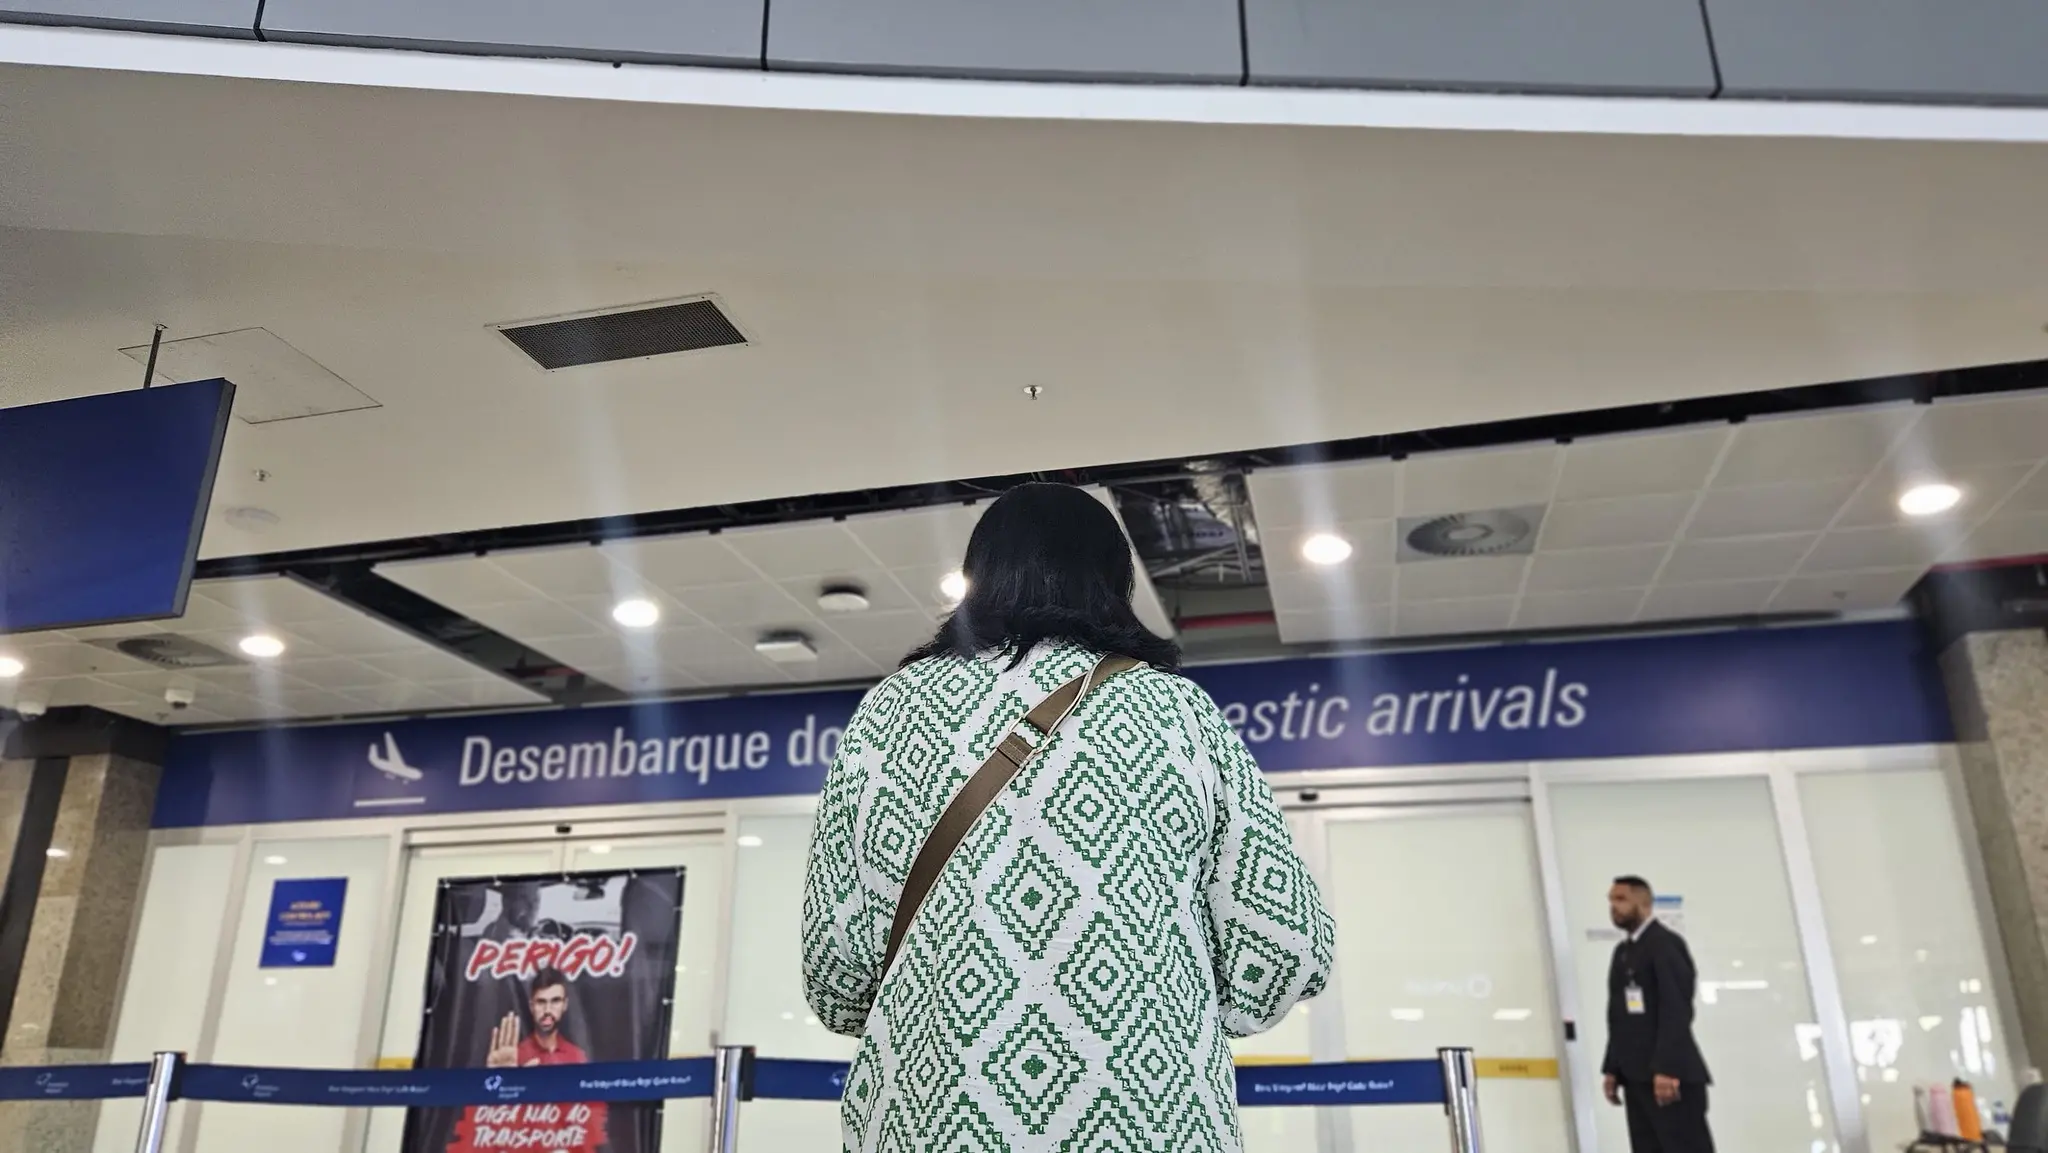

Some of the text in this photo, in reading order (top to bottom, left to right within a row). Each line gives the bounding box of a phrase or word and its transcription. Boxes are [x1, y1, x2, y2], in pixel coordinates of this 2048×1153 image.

[1366, 667, 1589, 737] arrivals
[459, 727, 771, 786] Desembarque
[466, 932, 637, 981] PERIGO!
[472, 1124, 590, 1149] TRANSPORTE
[473, 1103, 521, 1124] DIGA
[565, 1102, 592, 1123] AO
